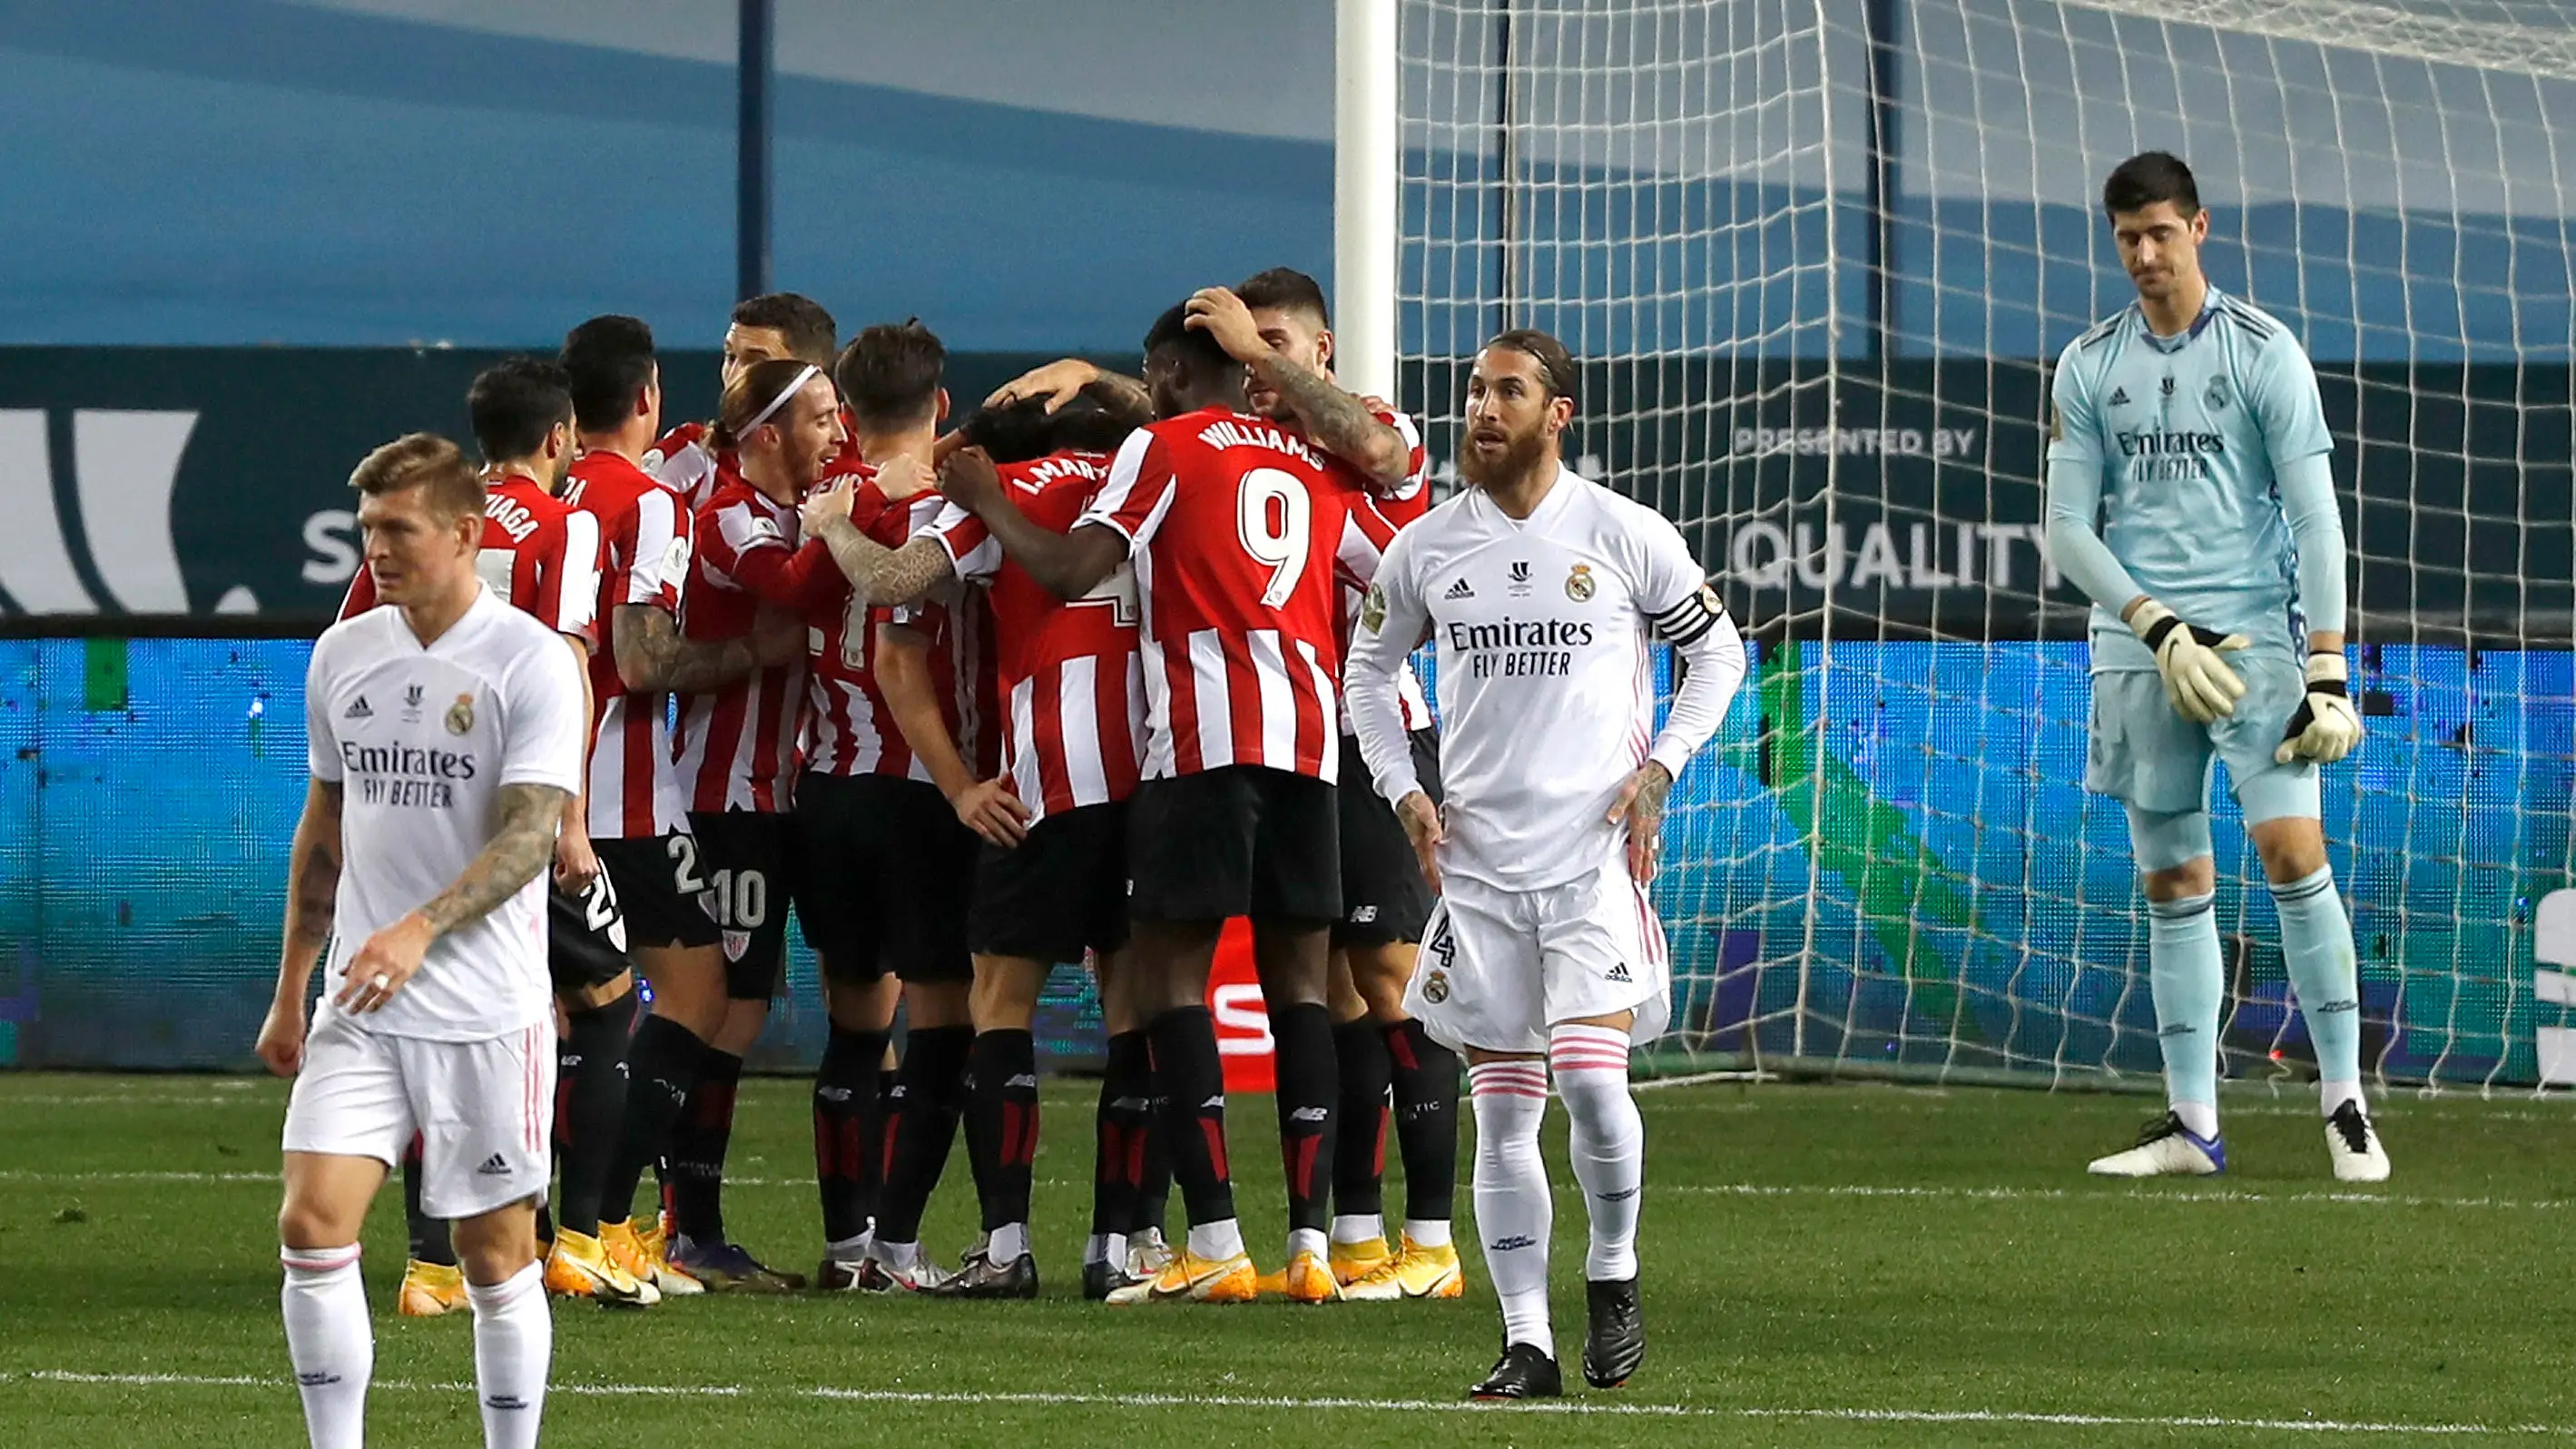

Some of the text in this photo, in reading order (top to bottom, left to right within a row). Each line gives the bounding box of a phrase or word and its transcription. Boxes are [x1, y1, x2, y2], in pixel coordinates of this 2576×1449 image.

[1197, 420, 1325, 472] WILLIAMS
[1733, 428, 1975, 455] PRESENTED BY
[2116, 427, 2224, 456] Emirates
[1236, 467, 1312, 611] 9
[1733, 521, 2062, 588] QUALITY
[1448, 616, 1593, 652] Emirates
[1472, 652, 1570, 679] FLY BETTER
[341, 740, 477, 780] Emirates
[390, 779, 453, 807] BETTER
[713, 869, 765, 929] 10
[1430, 908, 1455, 968] 4
